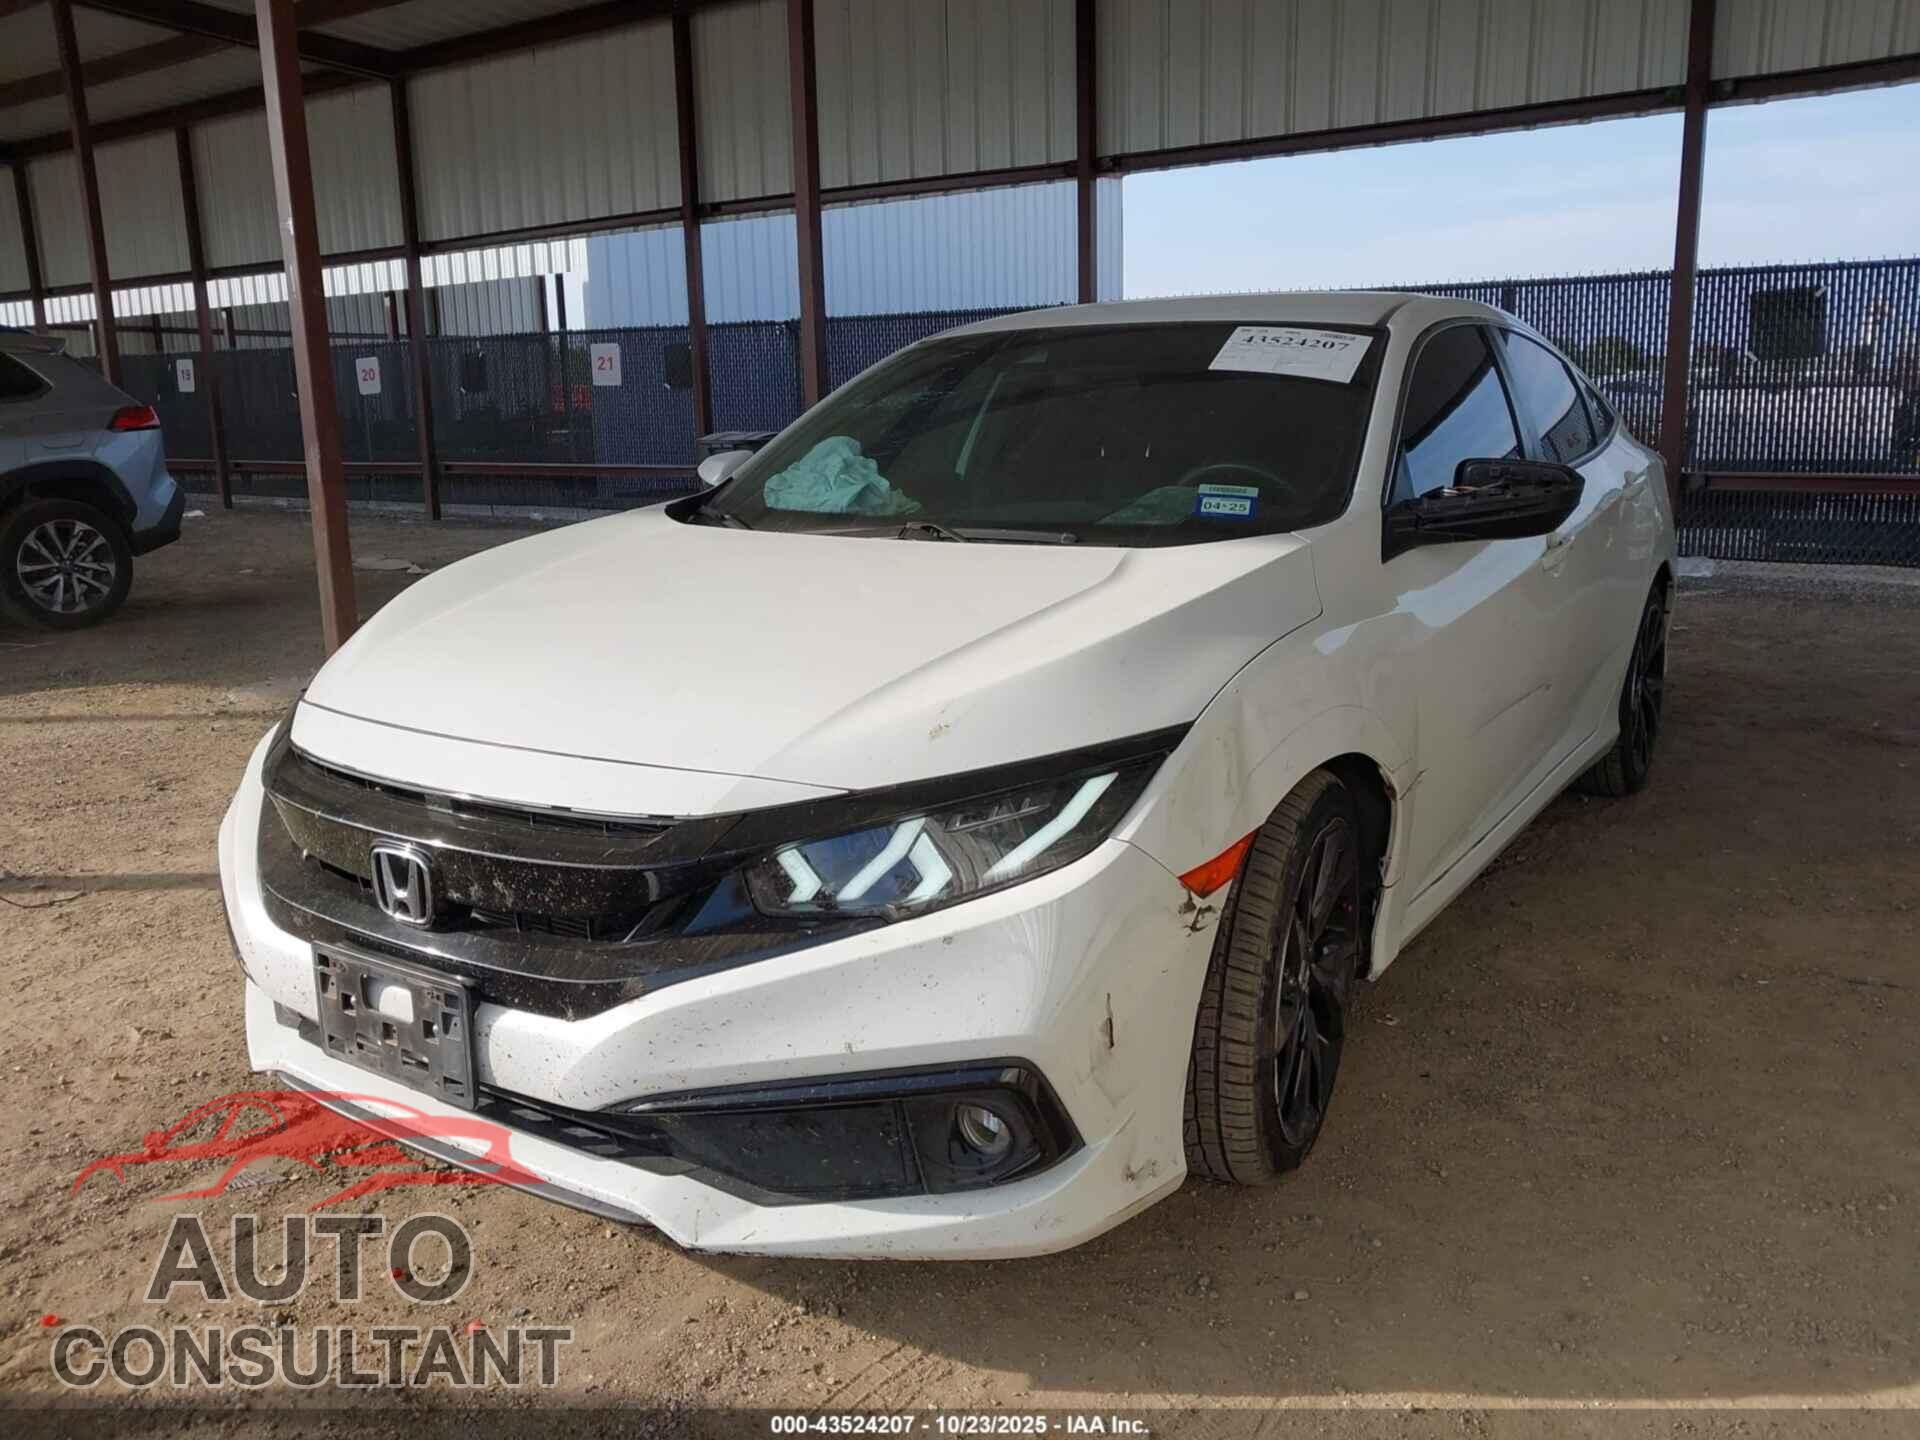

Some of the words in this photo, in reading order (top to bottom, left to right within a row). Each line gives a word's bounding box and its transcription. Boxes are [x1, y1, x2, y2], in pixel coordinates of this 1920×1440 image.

[1242, 335, 1350, 351] 43524207
[597, 356, 613, 370] 21
[361, 368, 376, 382] 20
